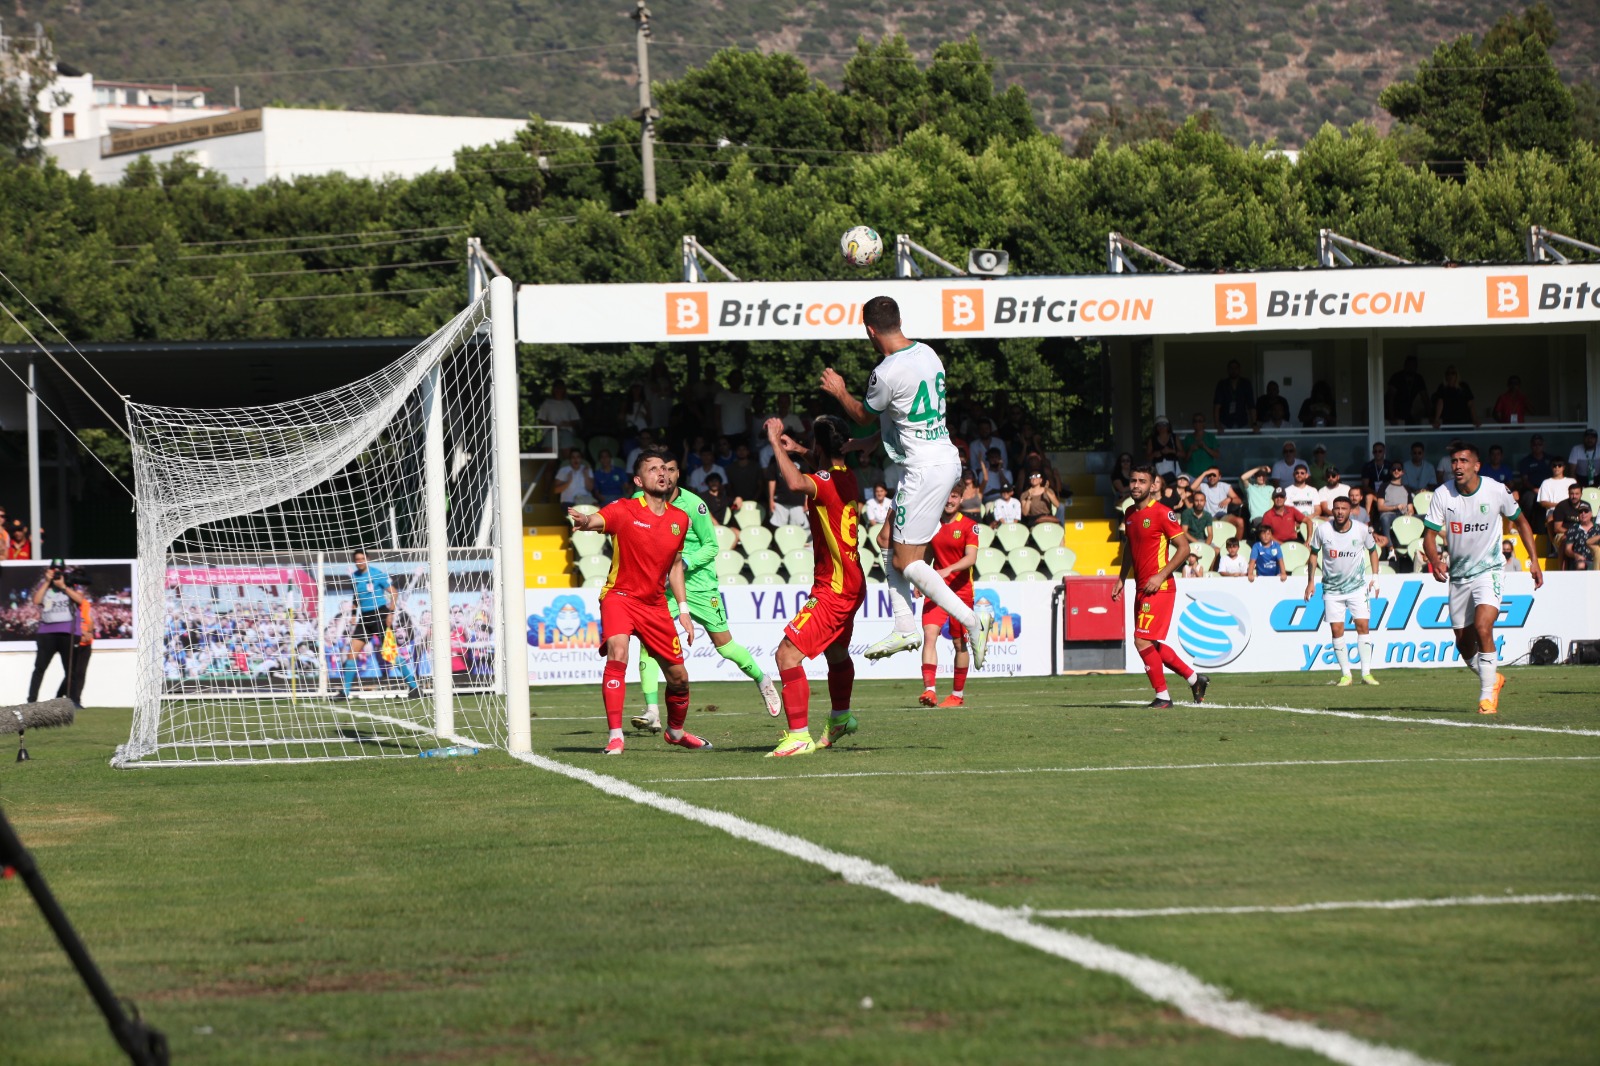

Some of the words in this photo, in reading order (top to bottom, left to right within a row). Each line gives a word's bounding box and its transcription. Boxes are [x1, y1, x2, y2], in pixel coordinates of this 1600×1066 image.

[1464, 523, 1489, 533] Bitci
[1138, 613, 1154, 629] 17
[538, 621, 600, 649] LUNA
[672, 636, 681, 655] 9
[1301, 642, 1374, 671] yap
[1384, 634, 1505, 664] mart
[537, 670, 603, 680] LUNAYACHTIN
